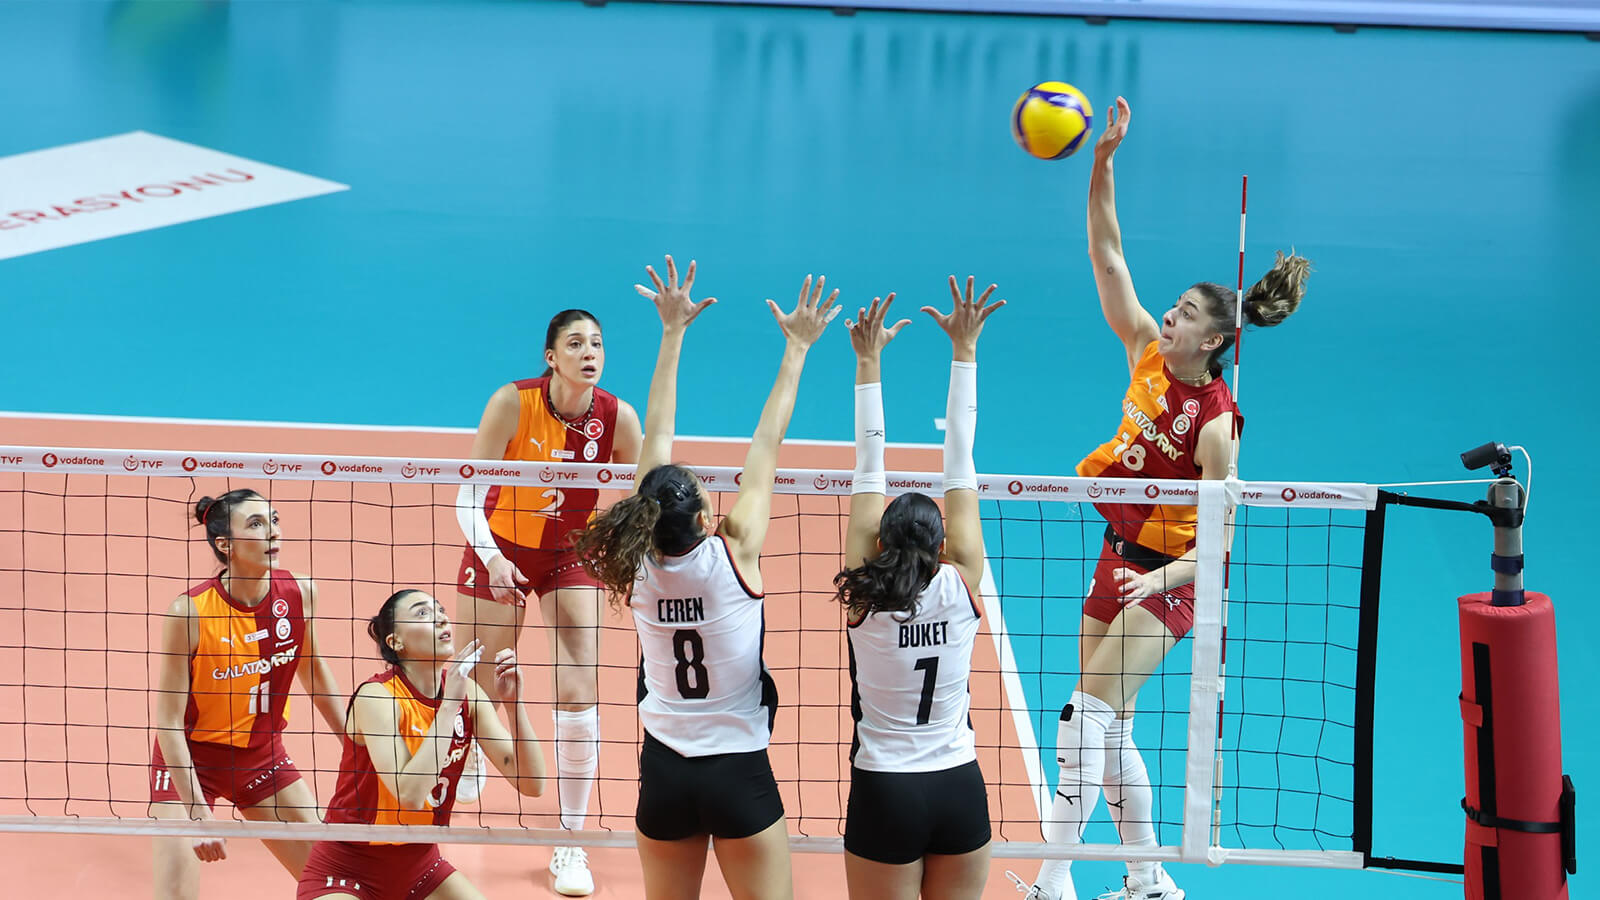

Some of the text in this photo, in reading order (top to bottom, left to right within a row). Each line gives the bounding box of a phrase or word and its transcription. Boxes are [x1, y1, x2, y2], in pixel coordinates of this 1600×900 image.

[1113, 432, 1146, 471] 18
[1, 456, 24, 465] TVF
[60, 456, 105, 466] vodafone
[140, 460, 163, 469] TVF
[199, 460, 244, 469] vodafone
[280, 463, 303, 473] TVF
[338, 464, 383, 473] vodafone
[418, 467, 441, 476] TVF
[476, 468, 521, 477] vodafone
[557, 471, 579, 481] TVF
[774, 476, 796, 484] fone
[831, 479, 853, 488] TVF
[888, 480, 933, 489] vodafone
[1025, 483, 1070, 493] vodafone
[1104, 487, 1126, 496] TVF
[1162, 488, 1198, 496] vodafon
[1241, 491, 1263, 500] TVF
[1298, 491, 1342, 500] vodafone
[534, 488, 565, 518] 2
[464, 566, 476, 588] 2
[657, 597, 705, 623] CEREN
[898, 620, 949, 649] BUKET
[672, 629, 710, 699] 8
[248, 680, 271, 714] 11
[155, 769, 170, 791] 11
